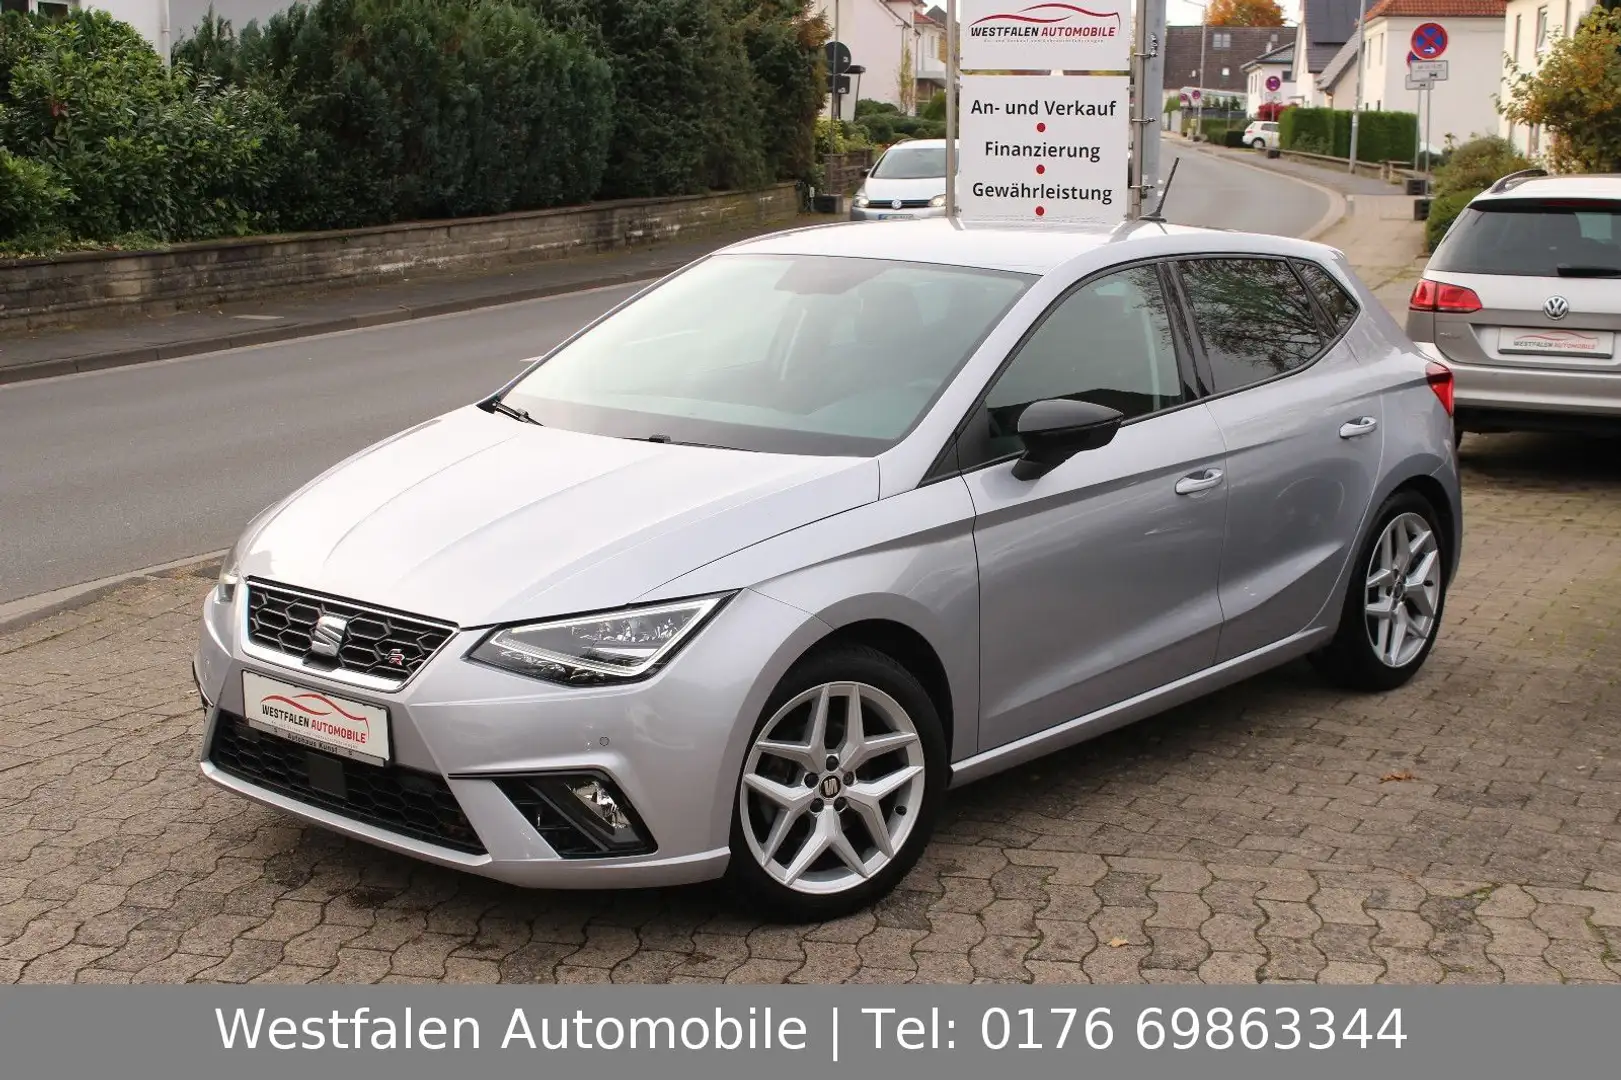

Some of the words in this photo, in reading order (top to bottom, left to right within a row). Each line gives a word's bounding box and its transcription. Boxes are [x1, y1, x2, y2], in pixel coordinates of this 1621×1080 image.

[970, 26, 1039, 37] WESTFALEN
[1041, 26, 1116, 37] AUTOMOBILE
[971, 100, 1000, 115] An-
[1005, 100, 1039, 115] und
[1044, 100, 1117, 116] Verkauf
[985, 141, 1101, 163] Finanzierung
[972, 182, 1113, 205] Gewährleistung
[262, 704, 310, 728] WESTFALEN
[311, 719, 366, 744] AUTOMOBILE
[287, 732, 317, 748] Autohaus
